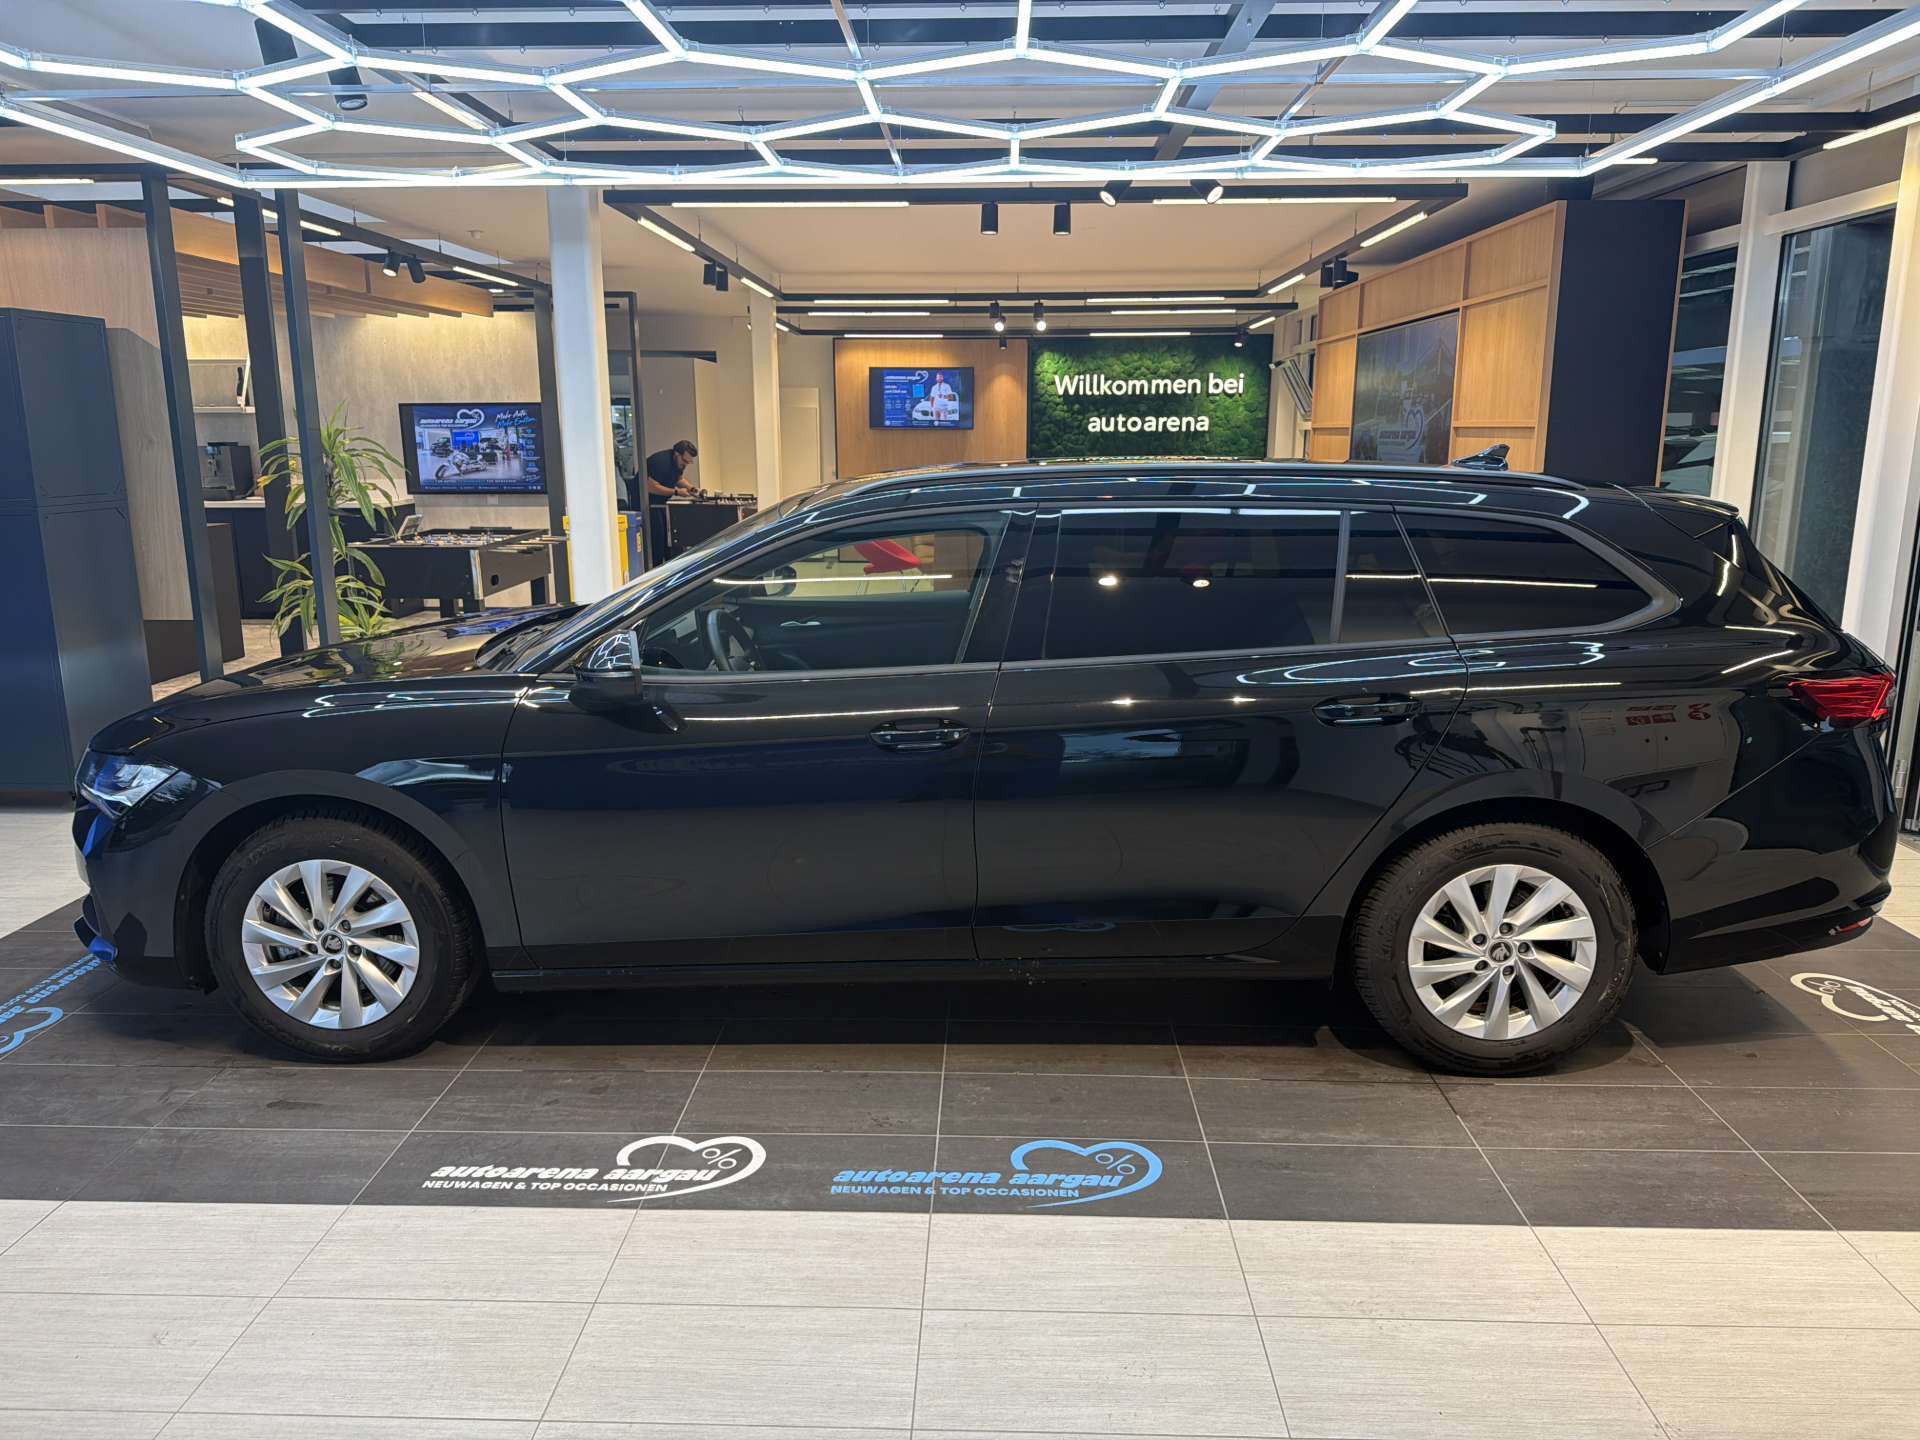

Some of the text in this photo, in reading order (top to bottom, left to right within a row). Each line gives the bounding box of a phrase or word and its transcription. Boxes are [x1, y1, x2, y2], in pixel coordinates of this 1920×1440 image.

[1054, 372, 1245, 395] Willkommen bei
[1088, 414, 1210, 432] autoarena
[430, 1164, 721, 1183] autoarena aargau
[832, 1168, 1124, 1189] autoarena aargau
[422, 1180, 668, 1192] NEUWAGEN & TOP OCCASIONEN
[830, 1185, 922, 1195] NEUWAGEN
[939, 1187, 971, 1196] TOP
[973, 1187, 1080, 1198] OCCASIONEN
